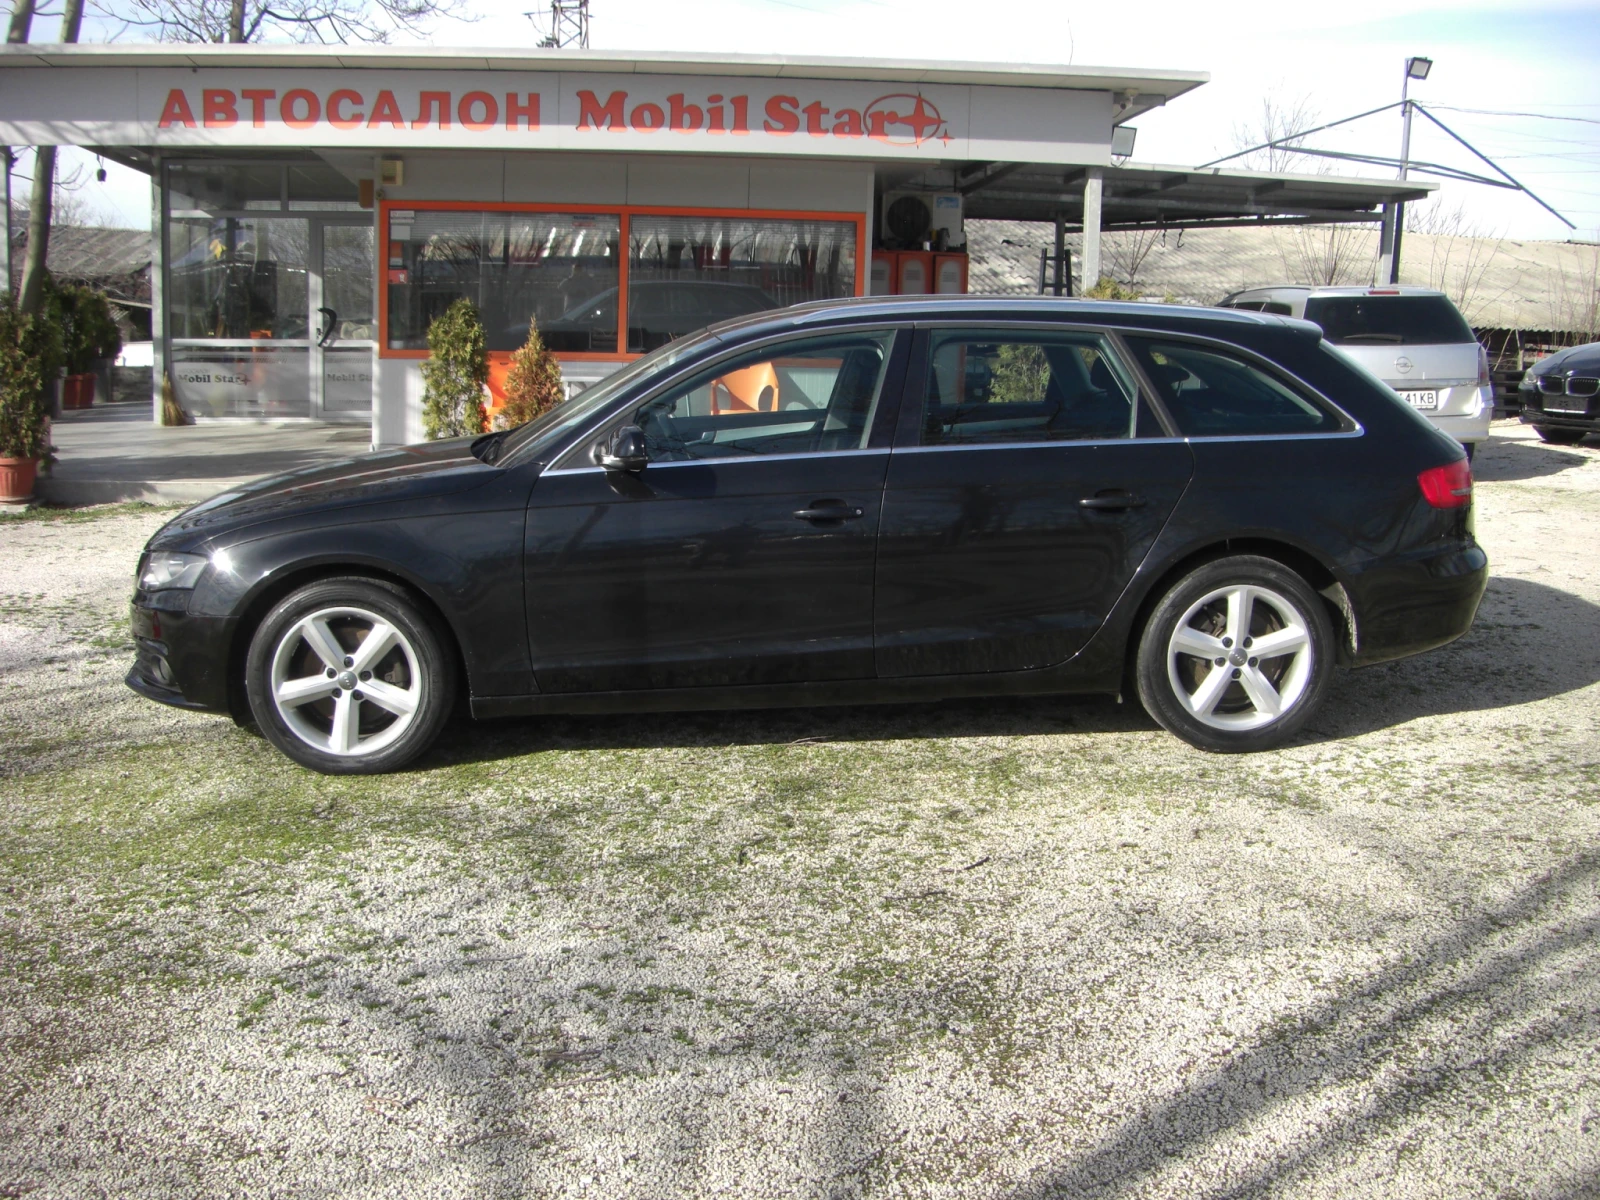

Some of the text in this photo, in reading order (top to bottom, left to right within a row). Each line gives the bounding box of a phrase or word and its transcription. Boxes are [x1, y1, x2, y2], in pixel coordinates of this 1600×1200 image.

[158, 88, 541, 132] АВТОСАЛОН
[575, 90, 899, 140] Mobil Star
[178, 374, 241, 384] Mobil Star
